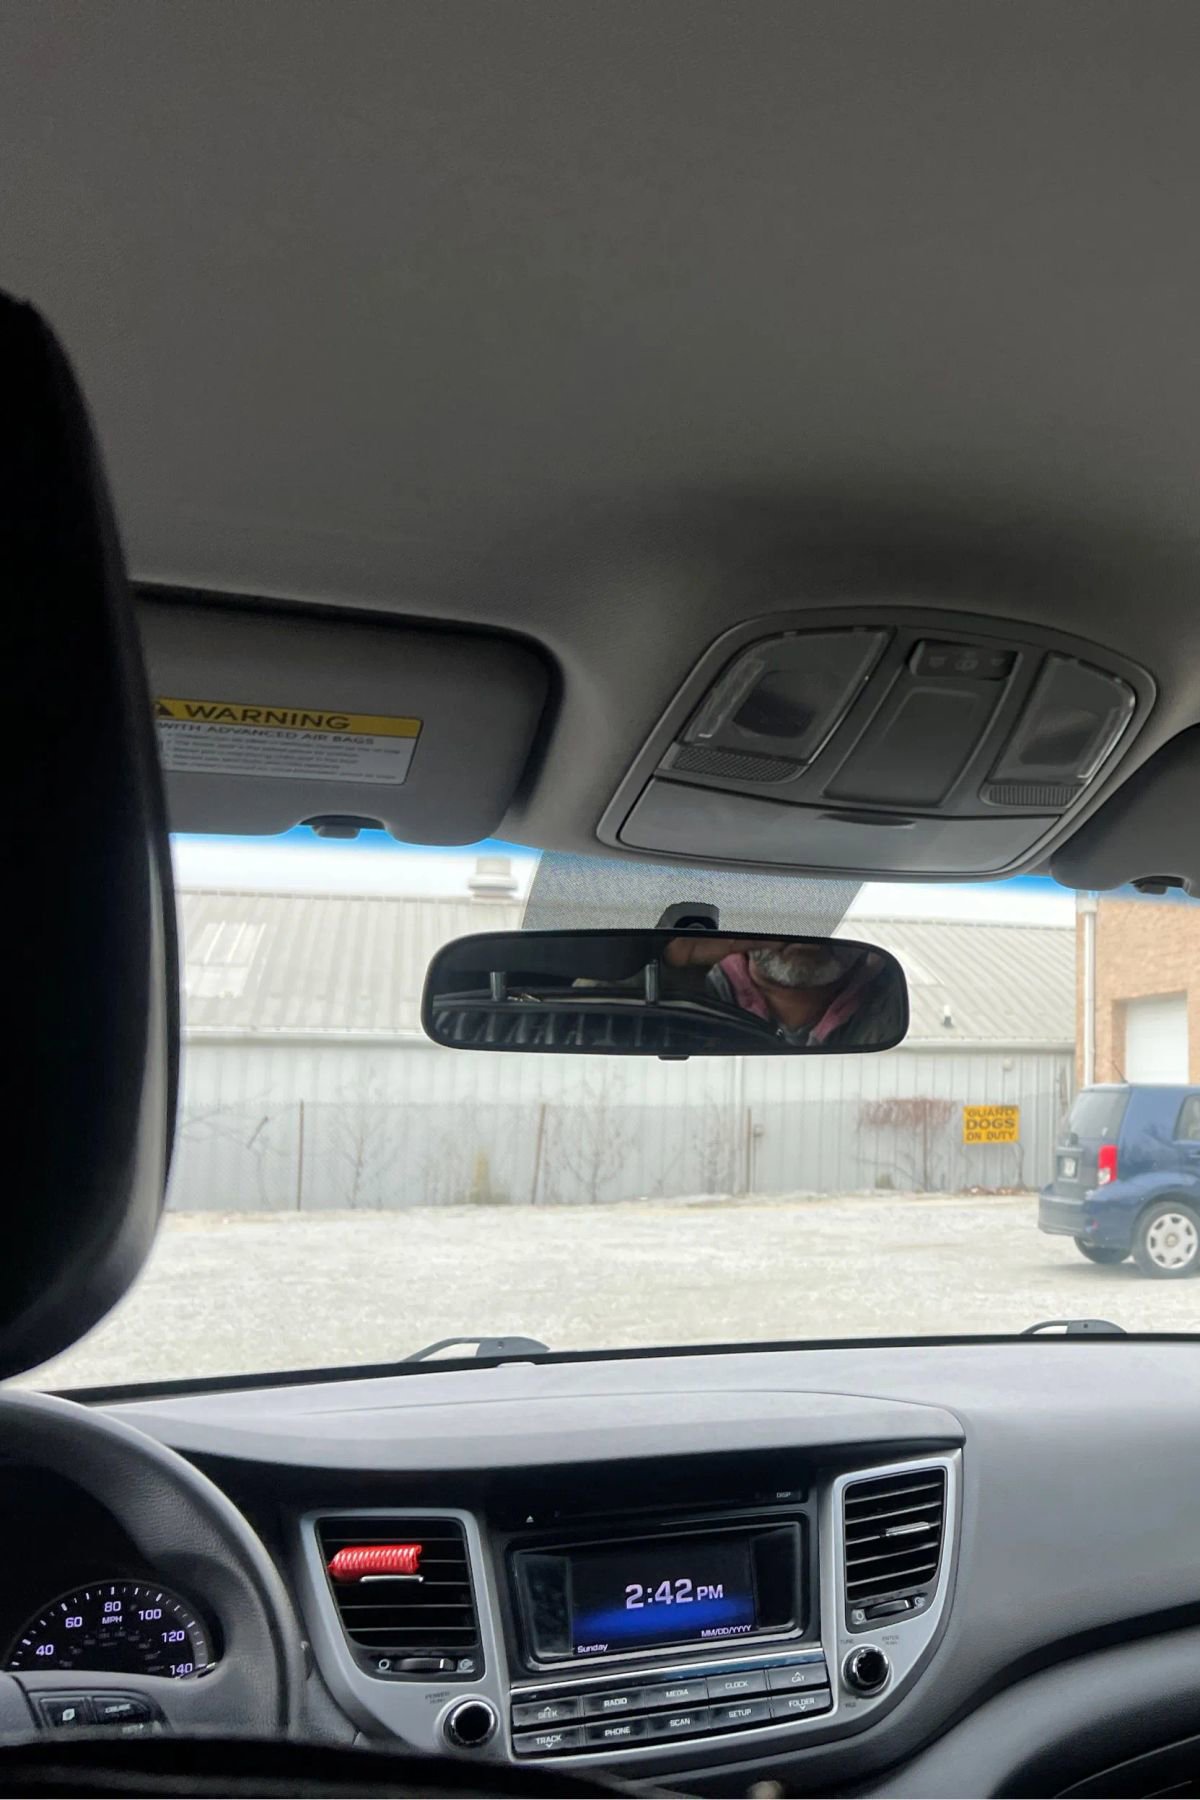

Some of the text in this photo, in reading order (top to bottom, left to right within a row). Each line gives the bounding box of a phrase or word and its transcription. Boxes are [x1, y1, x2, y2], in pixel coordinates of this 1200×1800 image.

[184, 704, 350, 730] WARNING
[158, 721, 375, 746] WITH ADVANCED AIR BAGS
[968, 1108, 1015, 1118] GUARD
[966, 1118, 1015, 1130] DOGS
[966, 1130, 1014, 1141] ON DUTY
[624, 1578, 723, 1609] 2:42 PM
[104, 1600, 122, 1612] 80
[101, 1615, 123, 1625] MPH
[138, 1608, 162, 1621] 100
[65, 1616, 83, 1628] 60
[161, 1630, 186, 1643] 120
[701, 1624, 752, 1638] MM/DD/YYYY
[35, 1644, 54, 1656] 40
[577, 1642, 608, 1654] Sunday
[169, 1662, 194, 1676] 140
[725, 1680, 749, 1690] CLOCK
[665, 1688, 689, 1698] MEDIA
[603, 1697, 628, 1708] RADIO
[788, 1696, 815, 1708] FOLDER
[537, 1710, 558, 1720] SEEK
[728, 1708, 752, 1719] SETUP
[669, 1717, 691, 1727] SCAN
[604, 1726, 631, 1737] PHONE
[535, 1734, 562, 1745] TRACK
